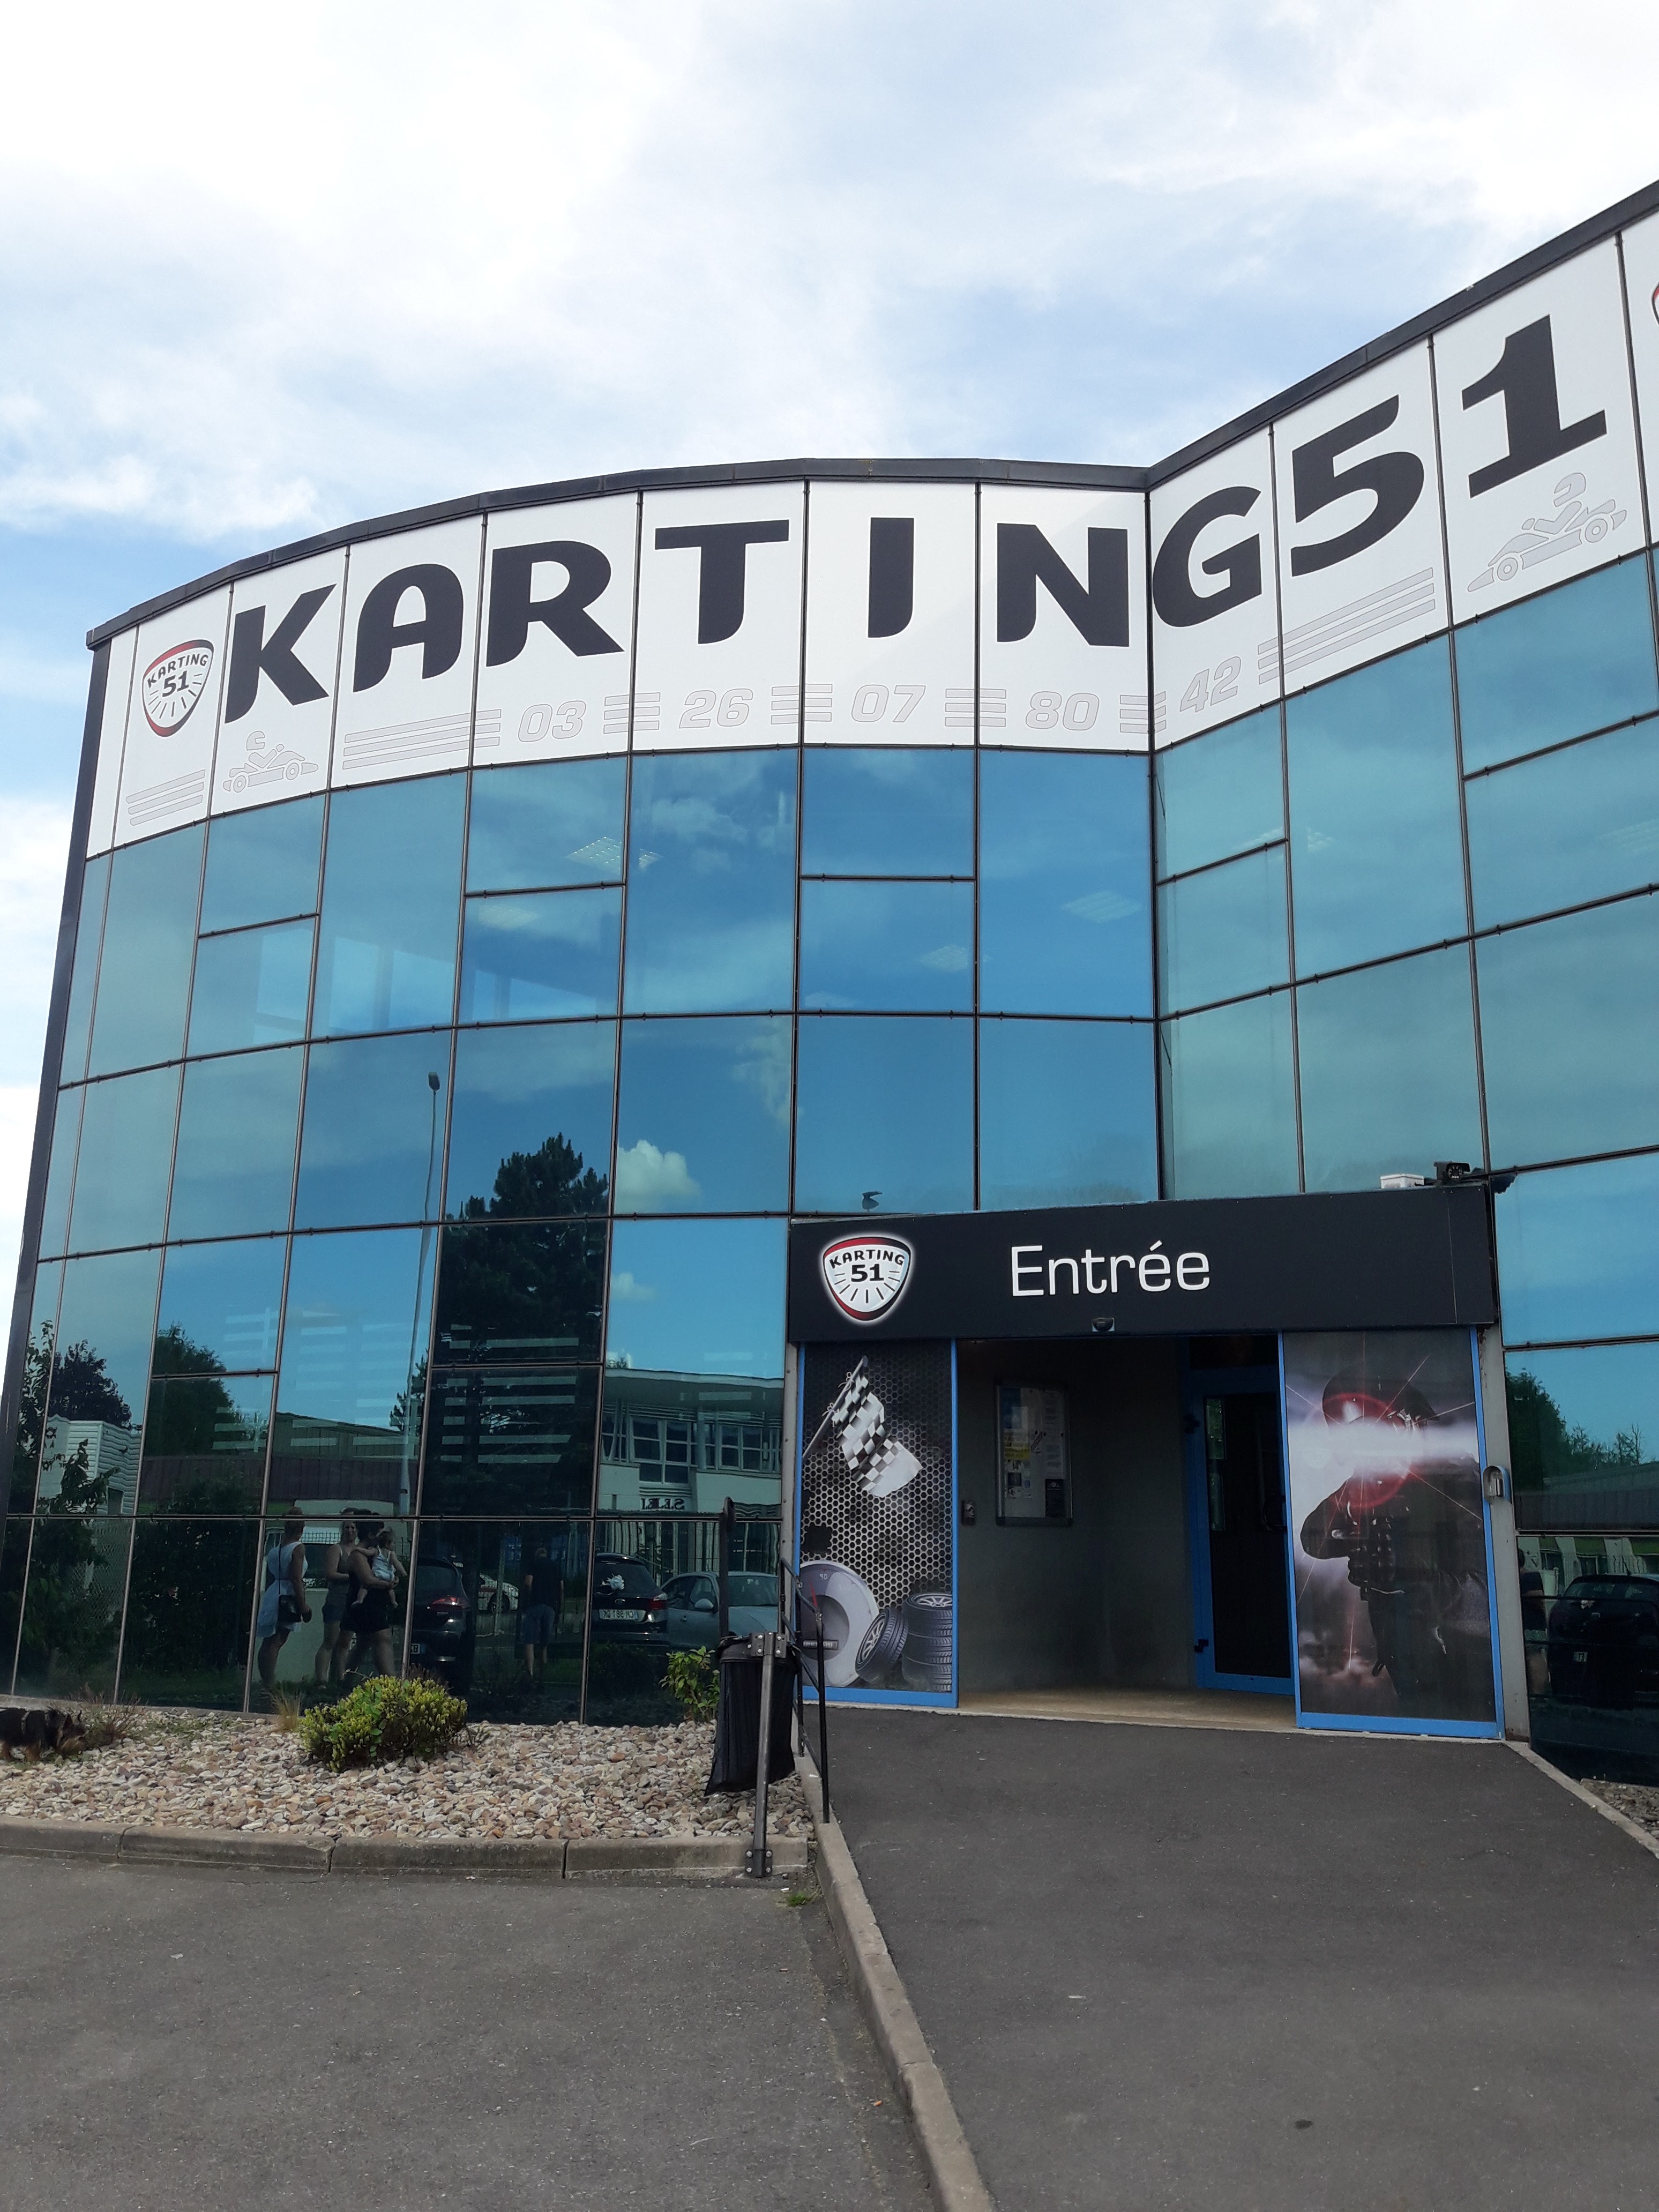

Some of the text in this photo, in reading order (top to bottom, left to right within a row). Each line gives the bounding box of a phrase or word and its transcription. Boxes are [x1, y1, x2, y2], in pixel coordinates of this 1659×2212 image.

[147, 653, 209, 689] KARTING
[162, 670, 189, 697] 51
[518, 656, 1242, 743] 03 26 07 80 42
[829, 1249, 905, 1269] KARTING
[851, 1263, 885, 1282] 51
[1011, 1240, 1210, 1297] Entrée
